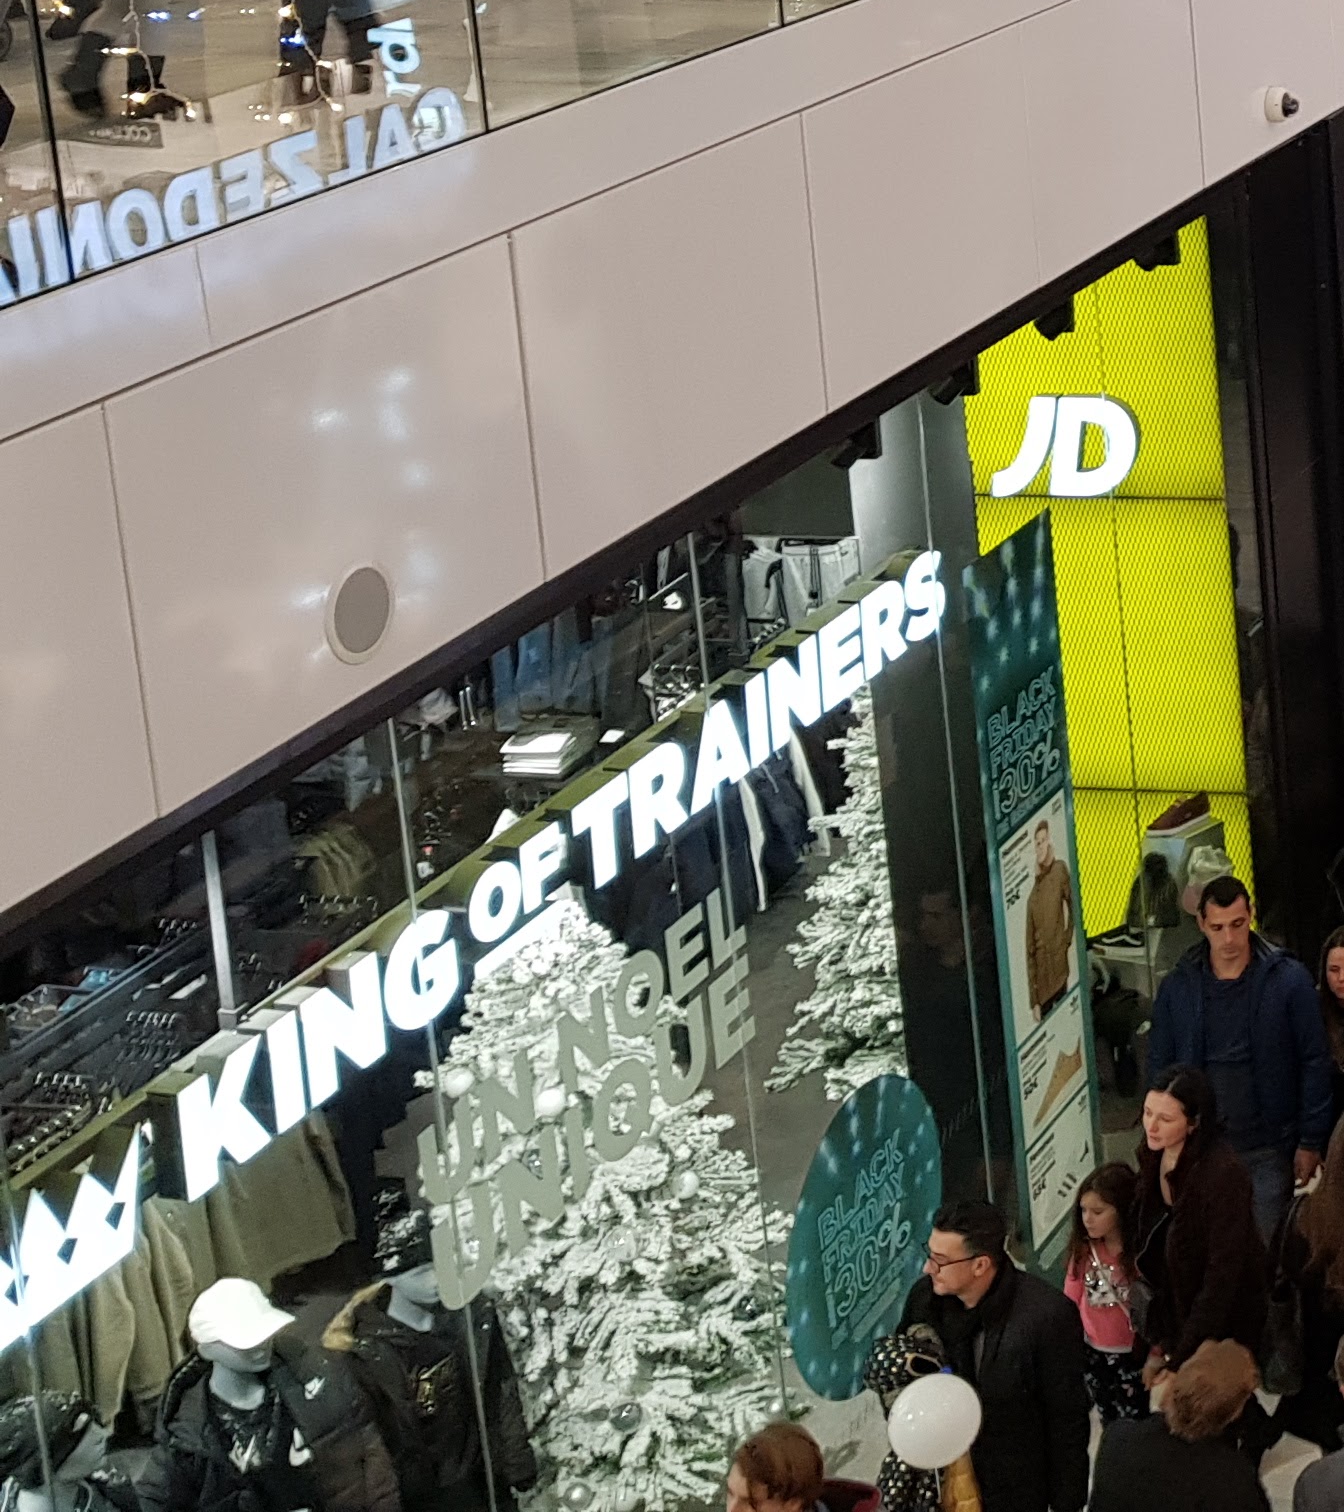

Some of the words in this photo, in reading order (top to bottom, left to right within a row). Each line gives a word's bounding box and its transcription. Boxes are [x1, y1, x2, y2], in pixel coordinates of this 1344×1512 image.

[991, 395, 1140, 498] JD
[988, 665, 1057, 748] BLACK
[990, 696, 1057, 779] FRIDAY
[177, 909, 460, 1204] KING
[468, 821, 569, 944] OF
[571, 549, 946, 891] TRAINERS
[417, 1052, 538, 1205] UN
[430, 952, 757, 1311] UNIQUE
[818, 1127, 904, 1250] BLACK
[821, 1161, 906, 1283] FRIDAY
